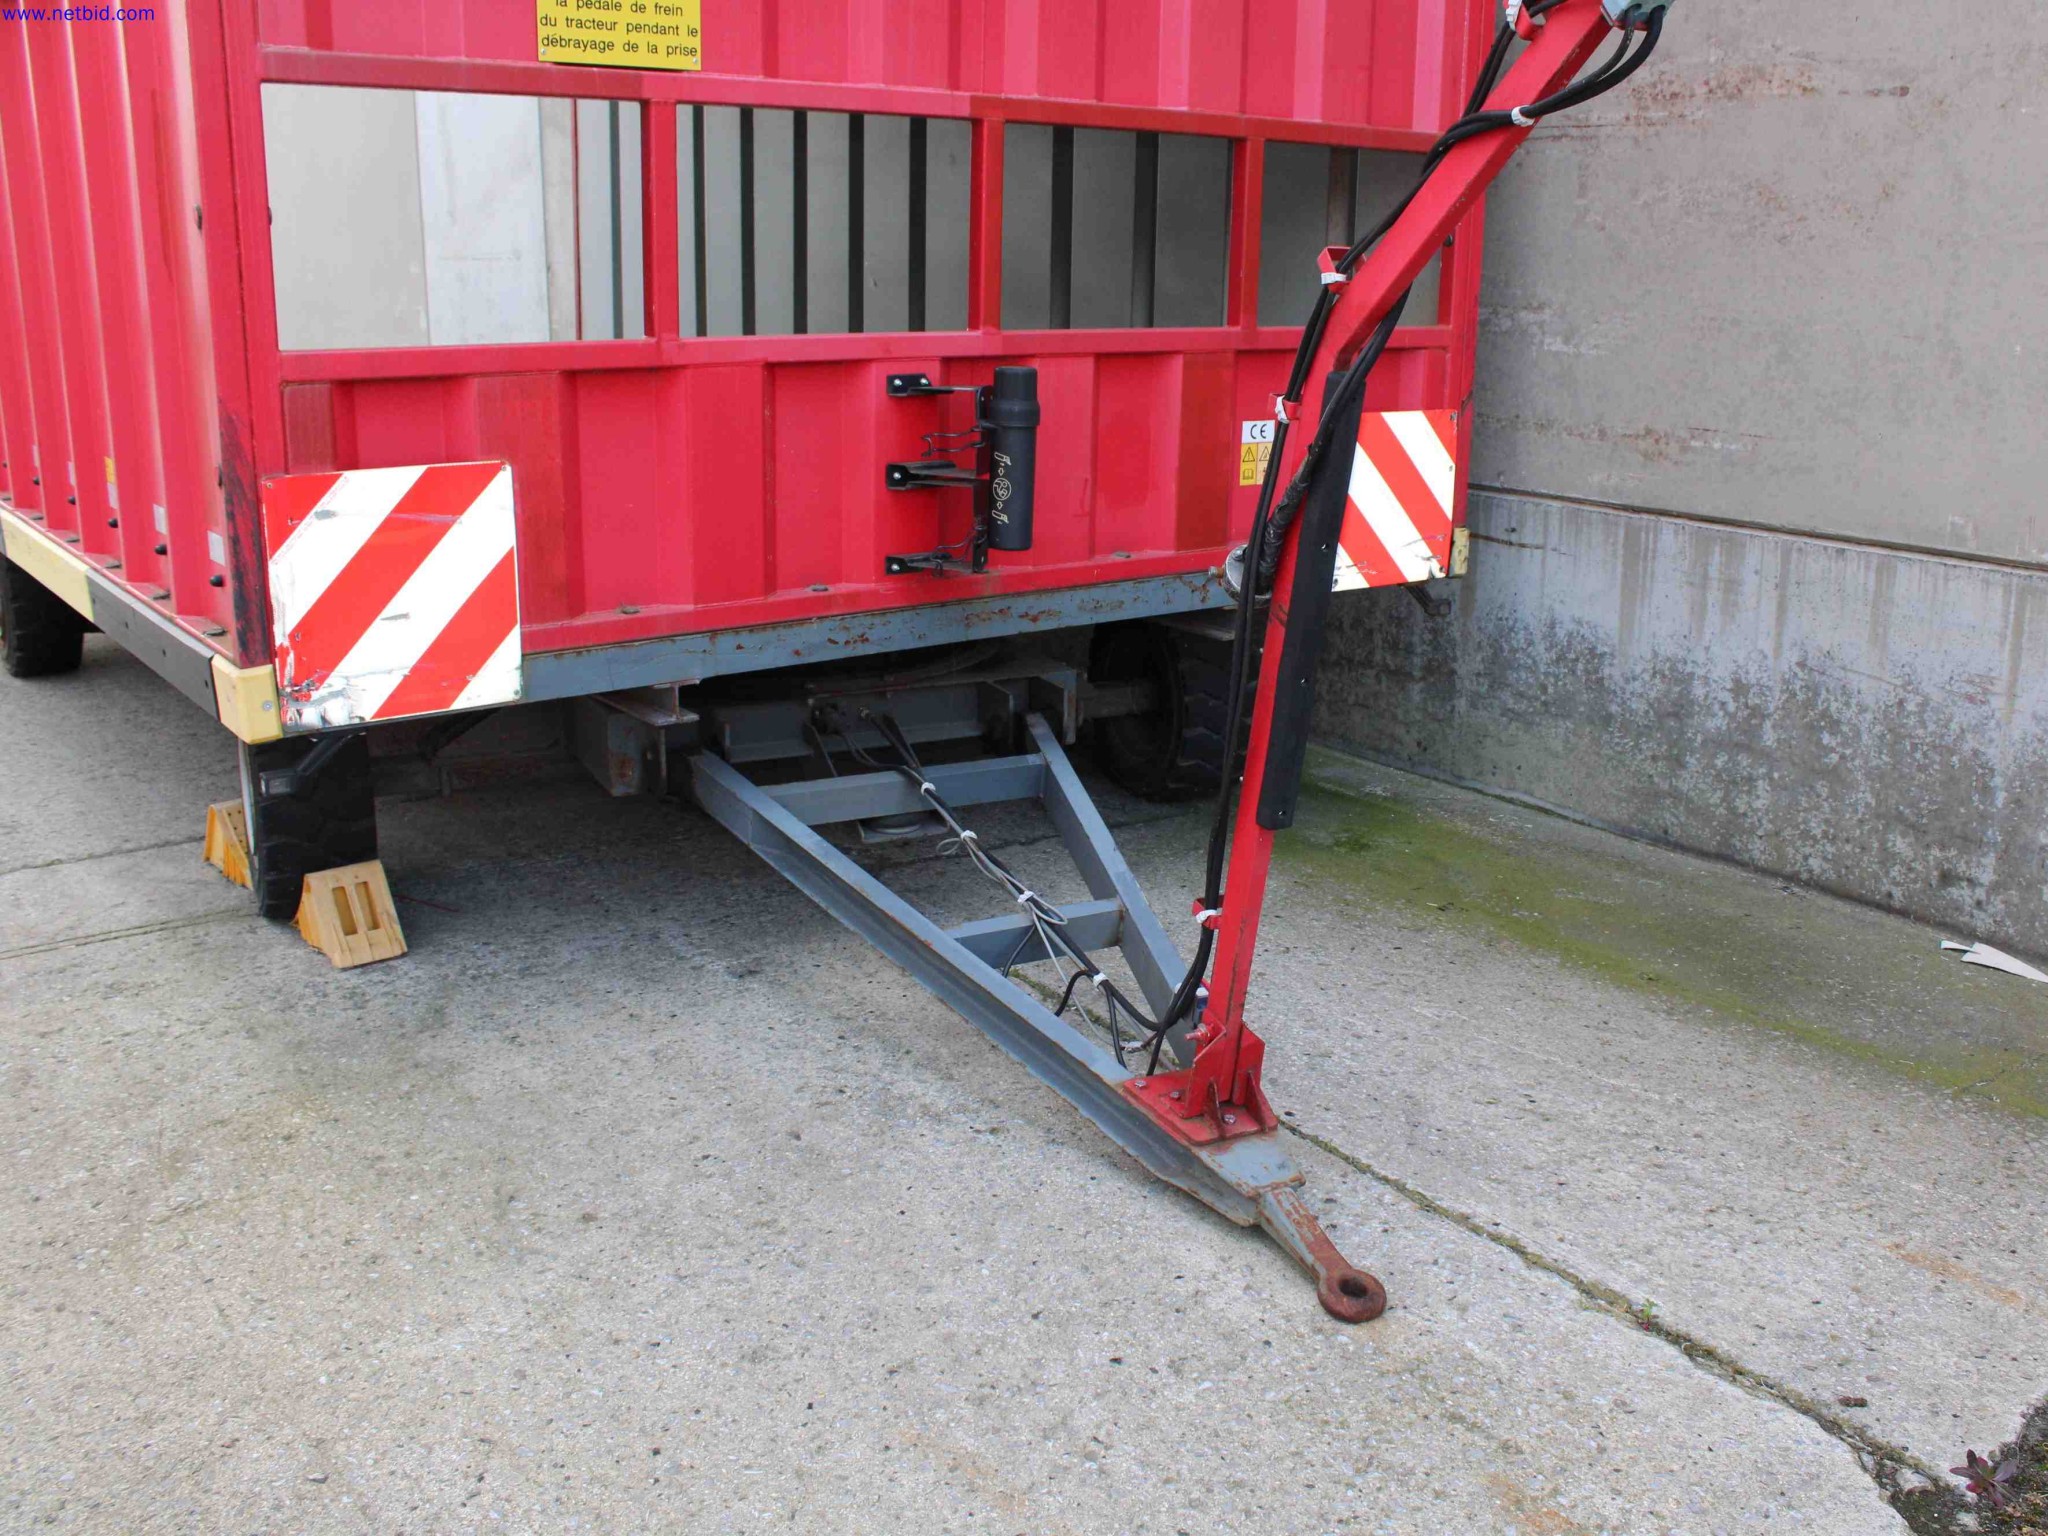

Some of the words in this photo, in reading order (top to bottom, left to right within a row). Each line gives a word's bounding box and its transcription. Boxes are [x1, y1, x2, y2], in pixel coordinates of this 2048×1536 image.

[630, 1, 646, 13] de
[654, 3, 683, 17] frein
[540, 14, 557, 27] du
[565, 16, 618, 31] tracteur
[626, 21, 680, 36] pendant
[687, 25, 698, 37] le
[541, 33, 615, 53] débrayage
[623, 40, 639, 53] de
[647, 42, 658, 54] la
[666, 45, 698, 57] prise
[1250, 423, 1267, 439] CE
